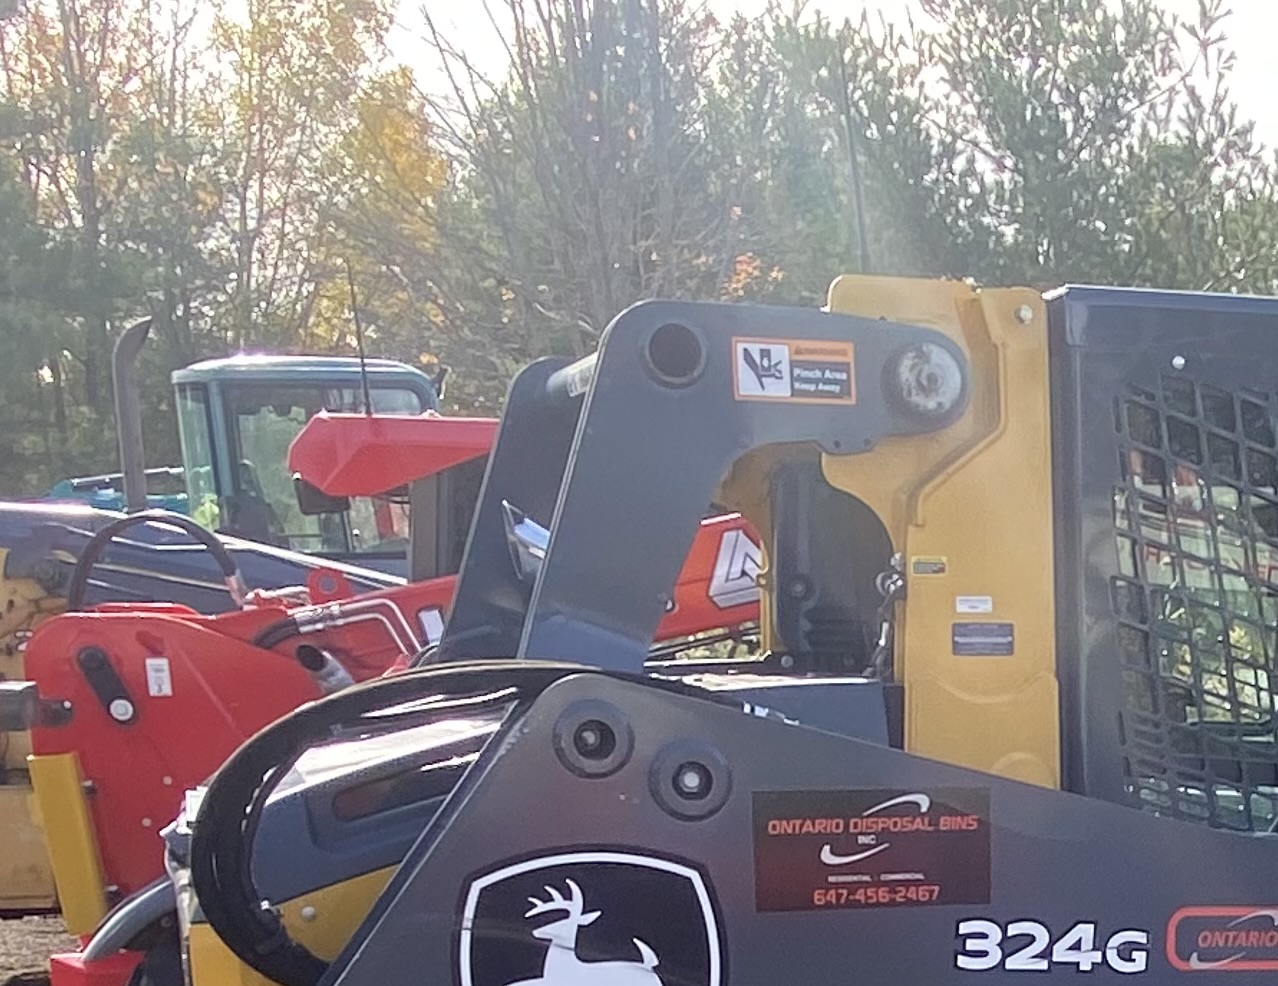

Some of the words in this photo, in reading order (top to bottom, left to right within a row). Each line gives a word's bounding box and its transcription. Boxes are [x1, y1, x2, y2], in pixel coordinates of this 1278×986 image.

[793, 367, 823, 379] Pinch
[824, 368, 848, 380] Area
[793, 382, 817, 392] Keep
[818, 382, 841, 394] Away
[768, 818, 844, 836] ONTARIO
[849, 816, 936, 834] DISPOSAL
[939, 815, 980, 831] BINS
[857, 835, 876, 845] INC
[813, 886, 940, 905] 647-456-2467
[956, 918, 1149, 974] 324G
